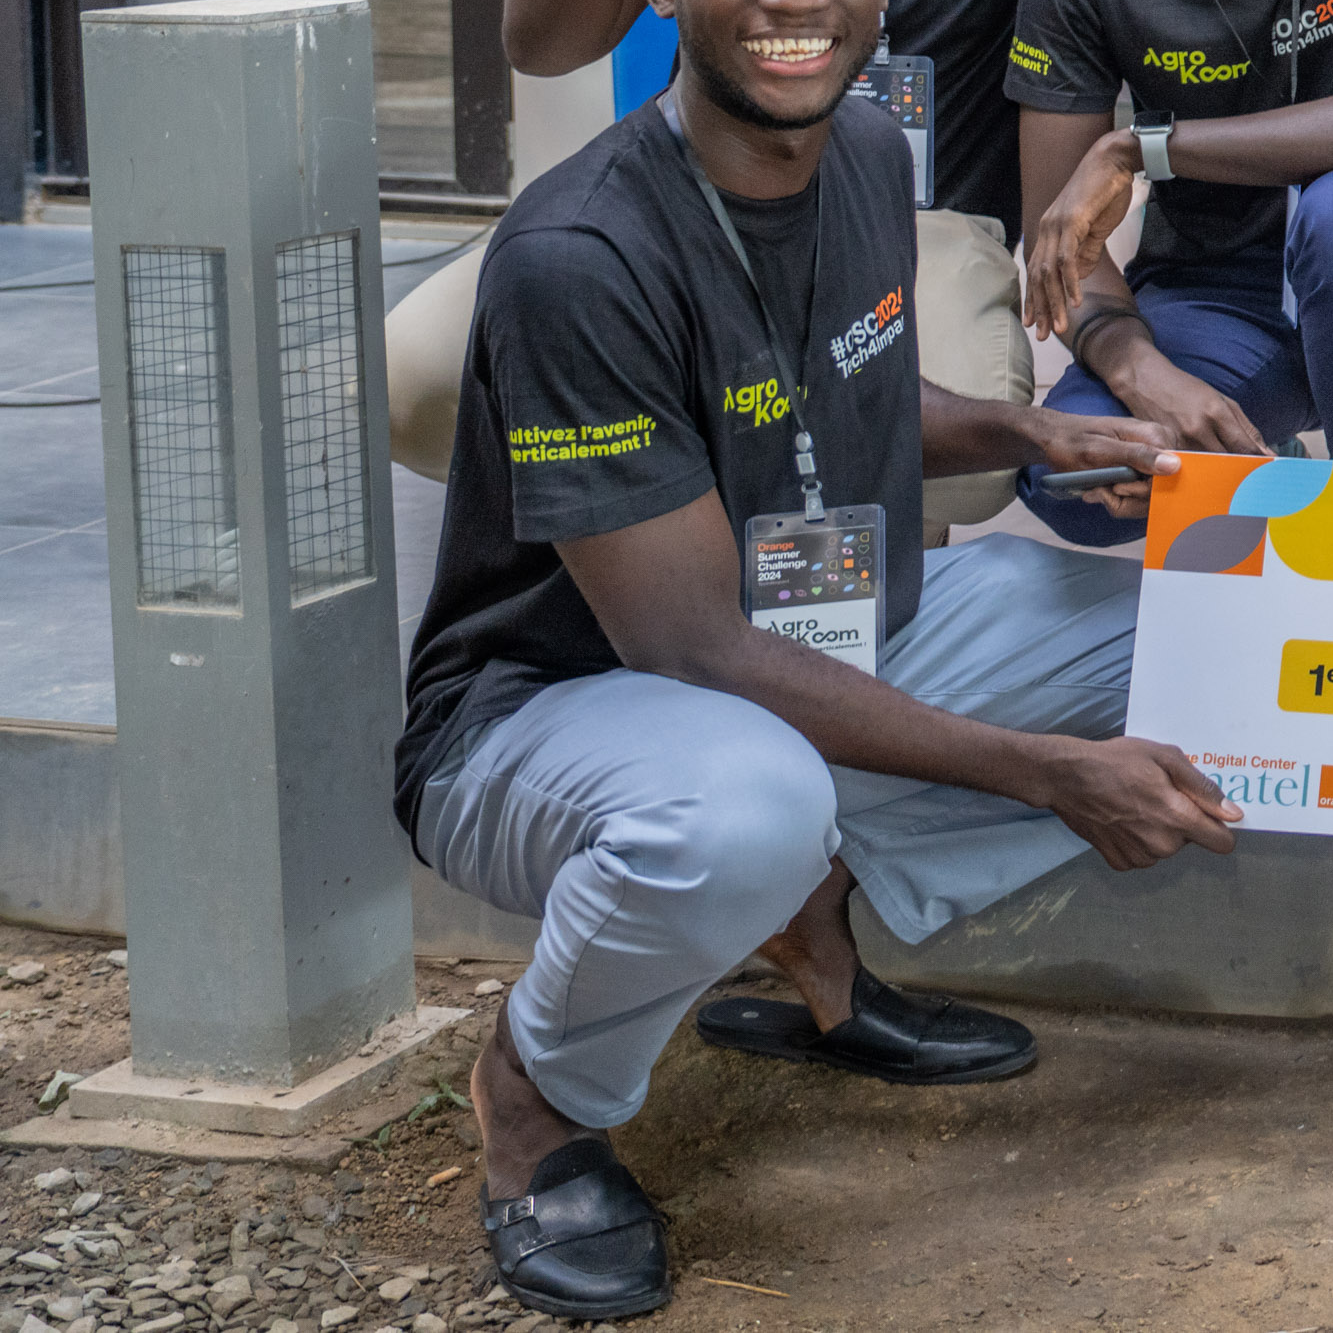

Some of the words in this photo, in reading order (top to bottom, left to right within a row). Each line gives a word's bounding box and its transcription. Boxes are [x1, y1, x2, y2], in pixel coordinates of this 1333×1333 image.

[1144, 47, 1206, 72] Agro
[724, 378, 778, 413] Agro
[510, 426, 576, 445] ultivez
[580, 414, 657, 440] l'avenir,
[511, 435, 641, 463] erticalement
[757, 542, 795, 553] Orange
[757, 550, 800, 562] Summer
[757, 559, 808, 573] Challenge
[757, 570, 782, 582] 2024
[1202, 752, 1247, 769] Digital
[1250, 755, 1297, 771] Center
